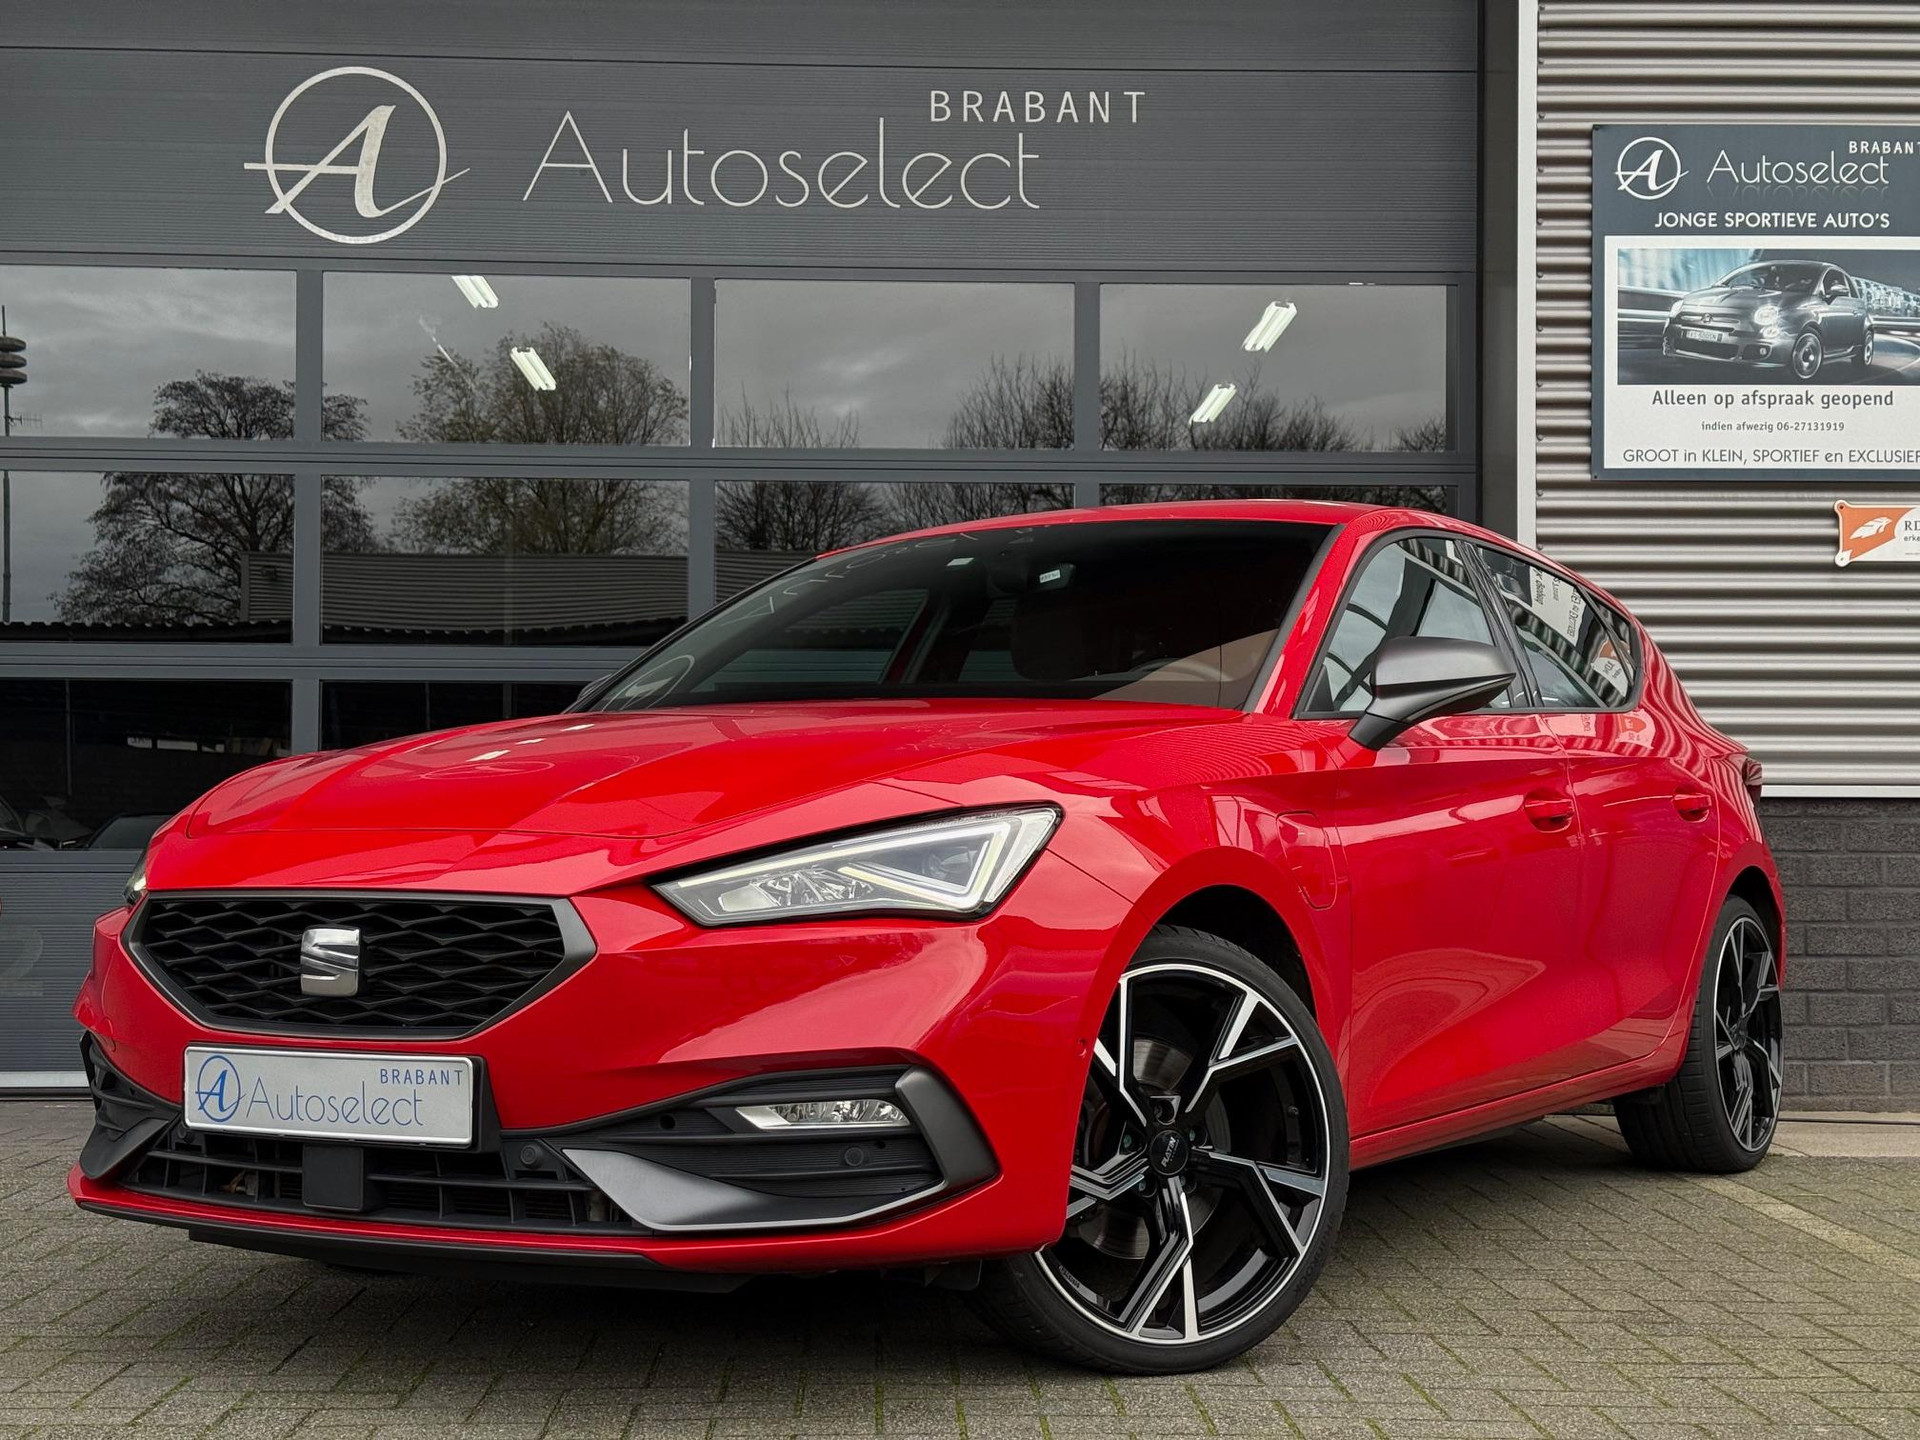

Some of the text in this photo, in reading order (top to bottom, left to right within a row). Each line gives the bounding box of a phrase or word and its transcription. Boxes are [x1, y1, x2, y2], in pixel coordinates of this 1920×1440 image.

[930, 90, 1146, 123] BRABANT
[522, 109, 1040, 210] Autoselect
[1706, 149, 1889, 185] Autoselect
[1654, 212, 1890, 228] JONGE SPORTIEVE AUTO'S
[1652, 390, 1893, 409] Alleen op afspraak geopend
[1701, 421, 1844, 433] indien afwezig 06-27131919
[1623, 449, 1678, 462] GROOT
[1684, 450, 1697, 462] in
[1703, 449, 1747, 465] KLEIN,
[1753, 449, 1820, 463] SPORTIEF
[1825, 452, 1843, 463] en
[380, 1068, 463, 1086] BRABANT
[246, 1076, 424, 1126] Autoselect
